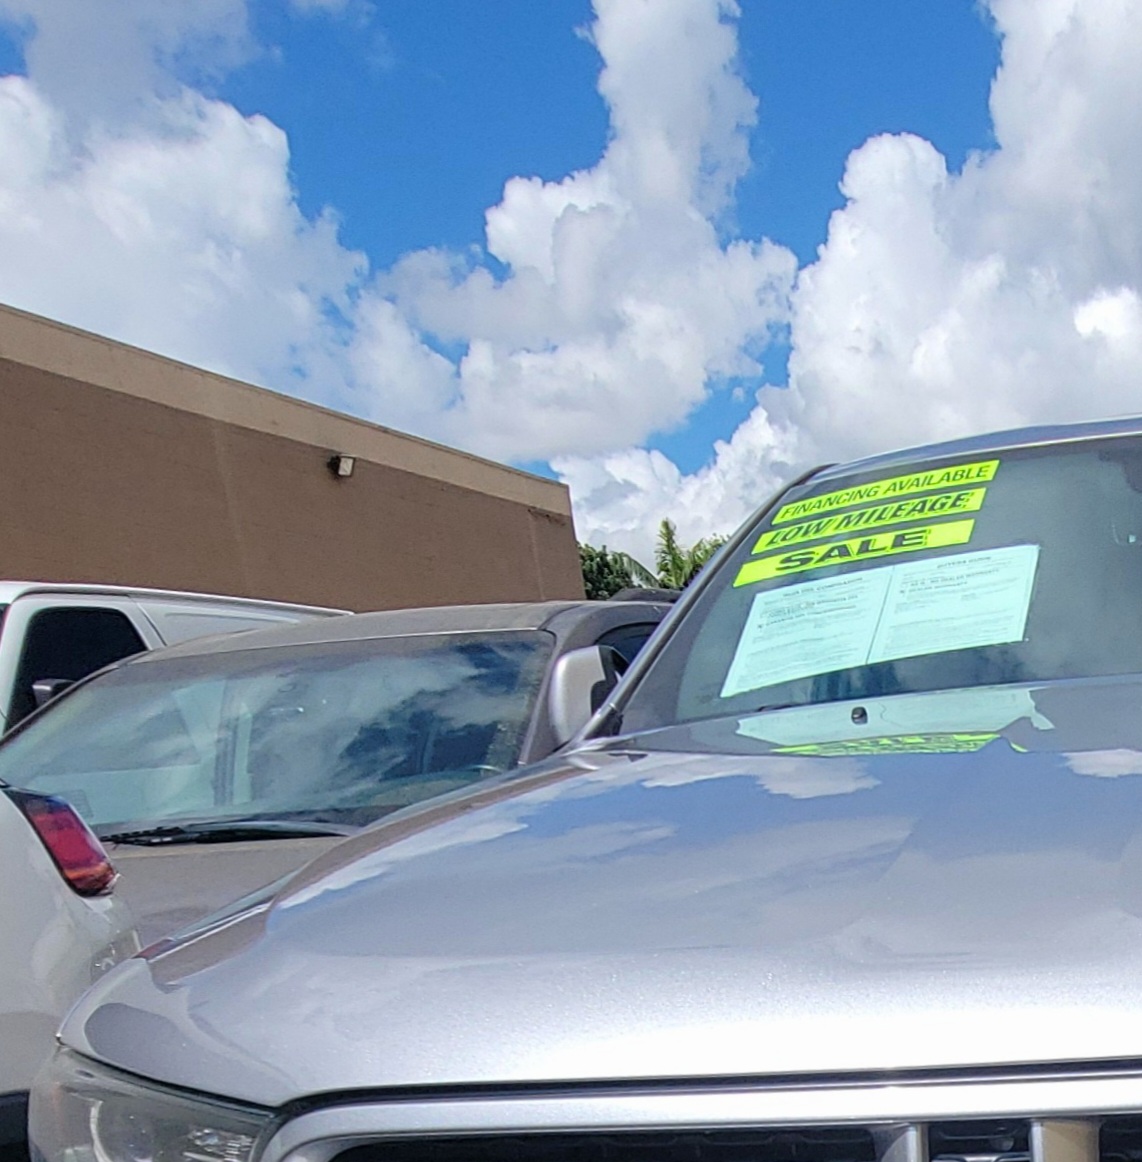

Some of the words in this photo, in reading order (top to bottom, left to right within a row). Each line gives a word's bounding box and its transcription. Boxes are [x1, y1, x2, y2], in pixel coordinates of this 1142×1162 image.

[765, 519, 834, 546] LOW
[834, 492, 973, 531] MILEAGE
[780, 485, 880, 519] FINANCING
[885, 465, 991, 495] AVAILABLE
[775, 529, 930, 572] SALE
